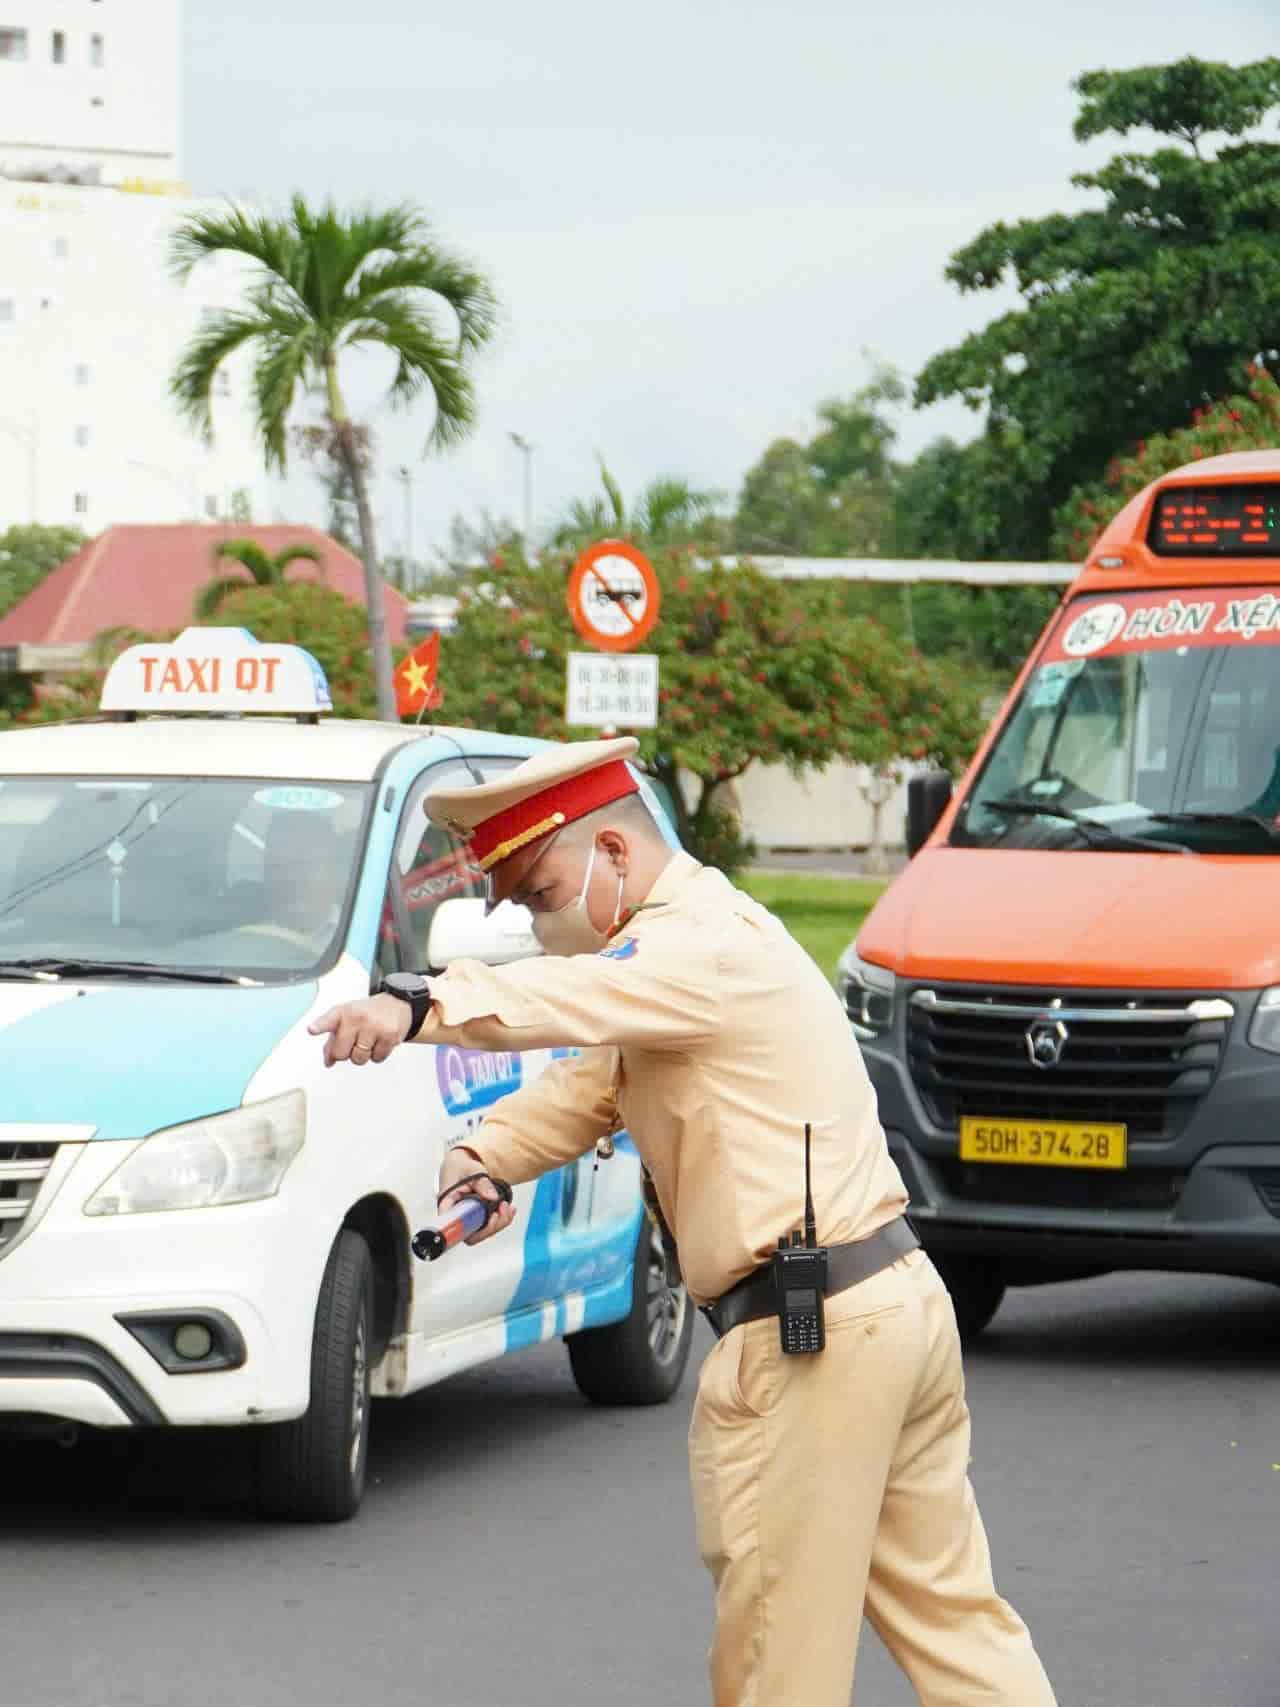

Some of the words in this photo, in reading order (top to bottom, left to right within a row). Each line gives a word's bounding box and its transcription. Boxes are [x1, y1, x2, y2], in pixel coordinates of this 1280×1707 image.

[1122, 600, 1215, 640] HÒN
[139, 657, 220, 693] TAXI
[235, 657, 281, 693] QT
[469, 1054, 496, 1089] TAXI
[975, 1127, 1110, 1159] 50H-374.28
